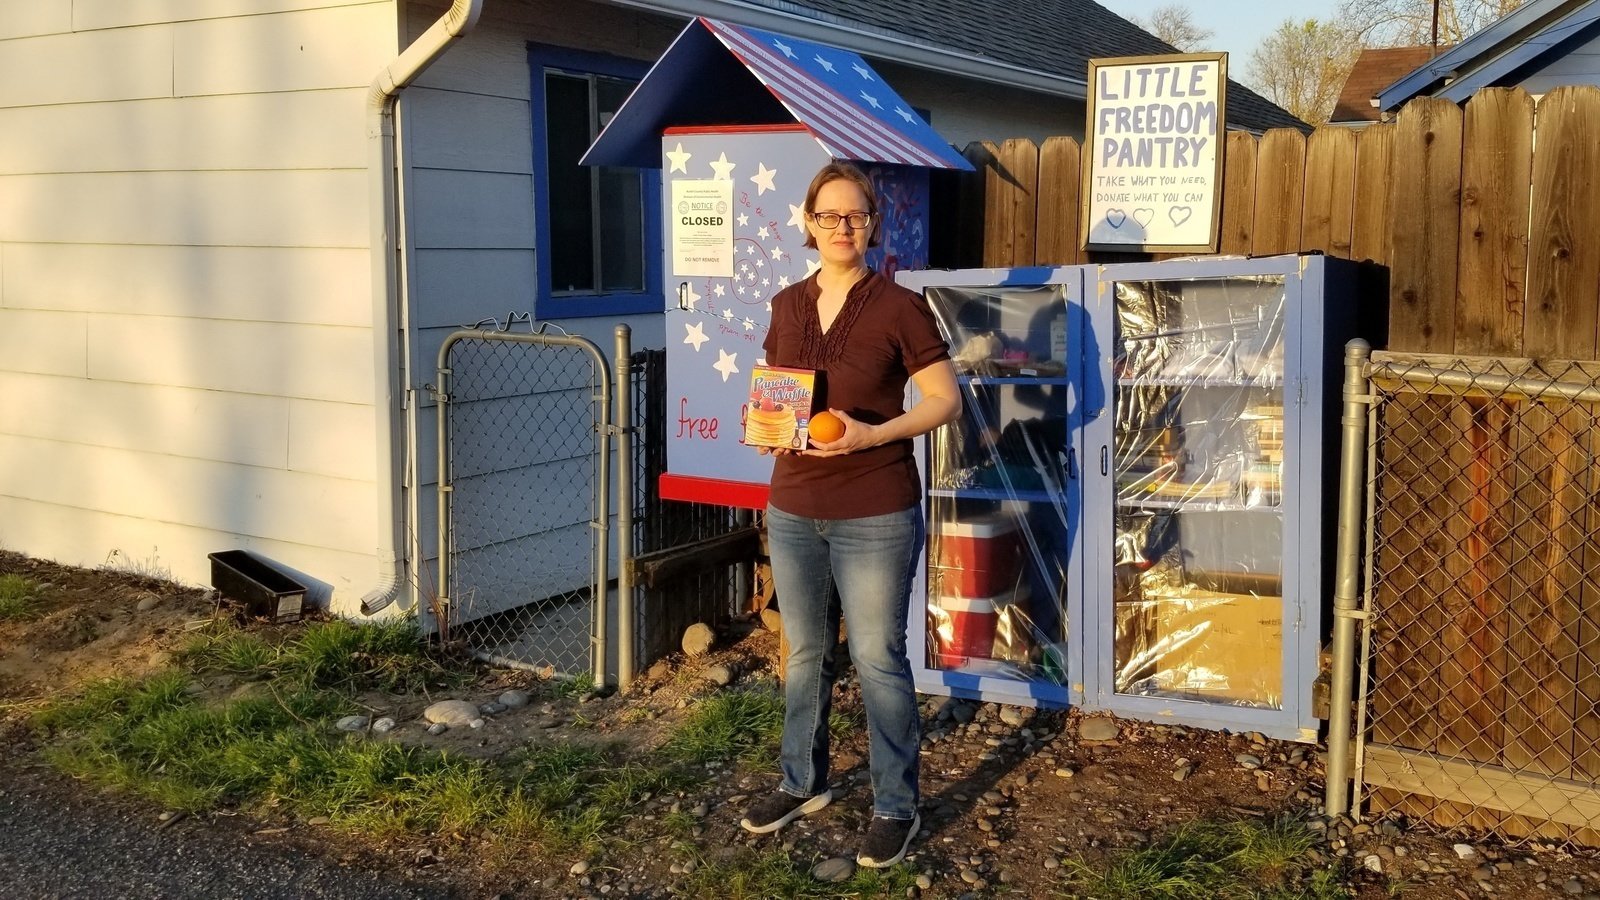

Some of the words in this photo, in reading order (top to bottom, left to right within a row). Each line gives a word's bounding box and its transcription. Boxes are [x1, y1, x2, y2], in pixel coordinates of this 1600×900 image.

[1100, 64, 1208, 100] LITTLE
[1099, 101, 1217, 135] FREEDOM
[1102, 136, 1208, 168] PANTRY
[1096, 175, 1125, 187] TAKE
[1130, 175, 1157, 186] WHAT
[1159, 175, 1176, 186] YOU
[739, 191, 751, 208] Be
[1096, 192, 1131, 203] DONATE
[1133, 192, 1159, 203] WHAT
[1162, 192, 1179, 203] YOU
[1184, 192, 1204, 203] CAN
[691, 202, 713, 210] NOTICE
[681, 216, 724, 226] CLOSED
[753, 376, 799, 392] Pancake
[762, 389, 772, 398] &
[772, 387, 811, 402] Waffle
[676, 397, 719, 440] free
